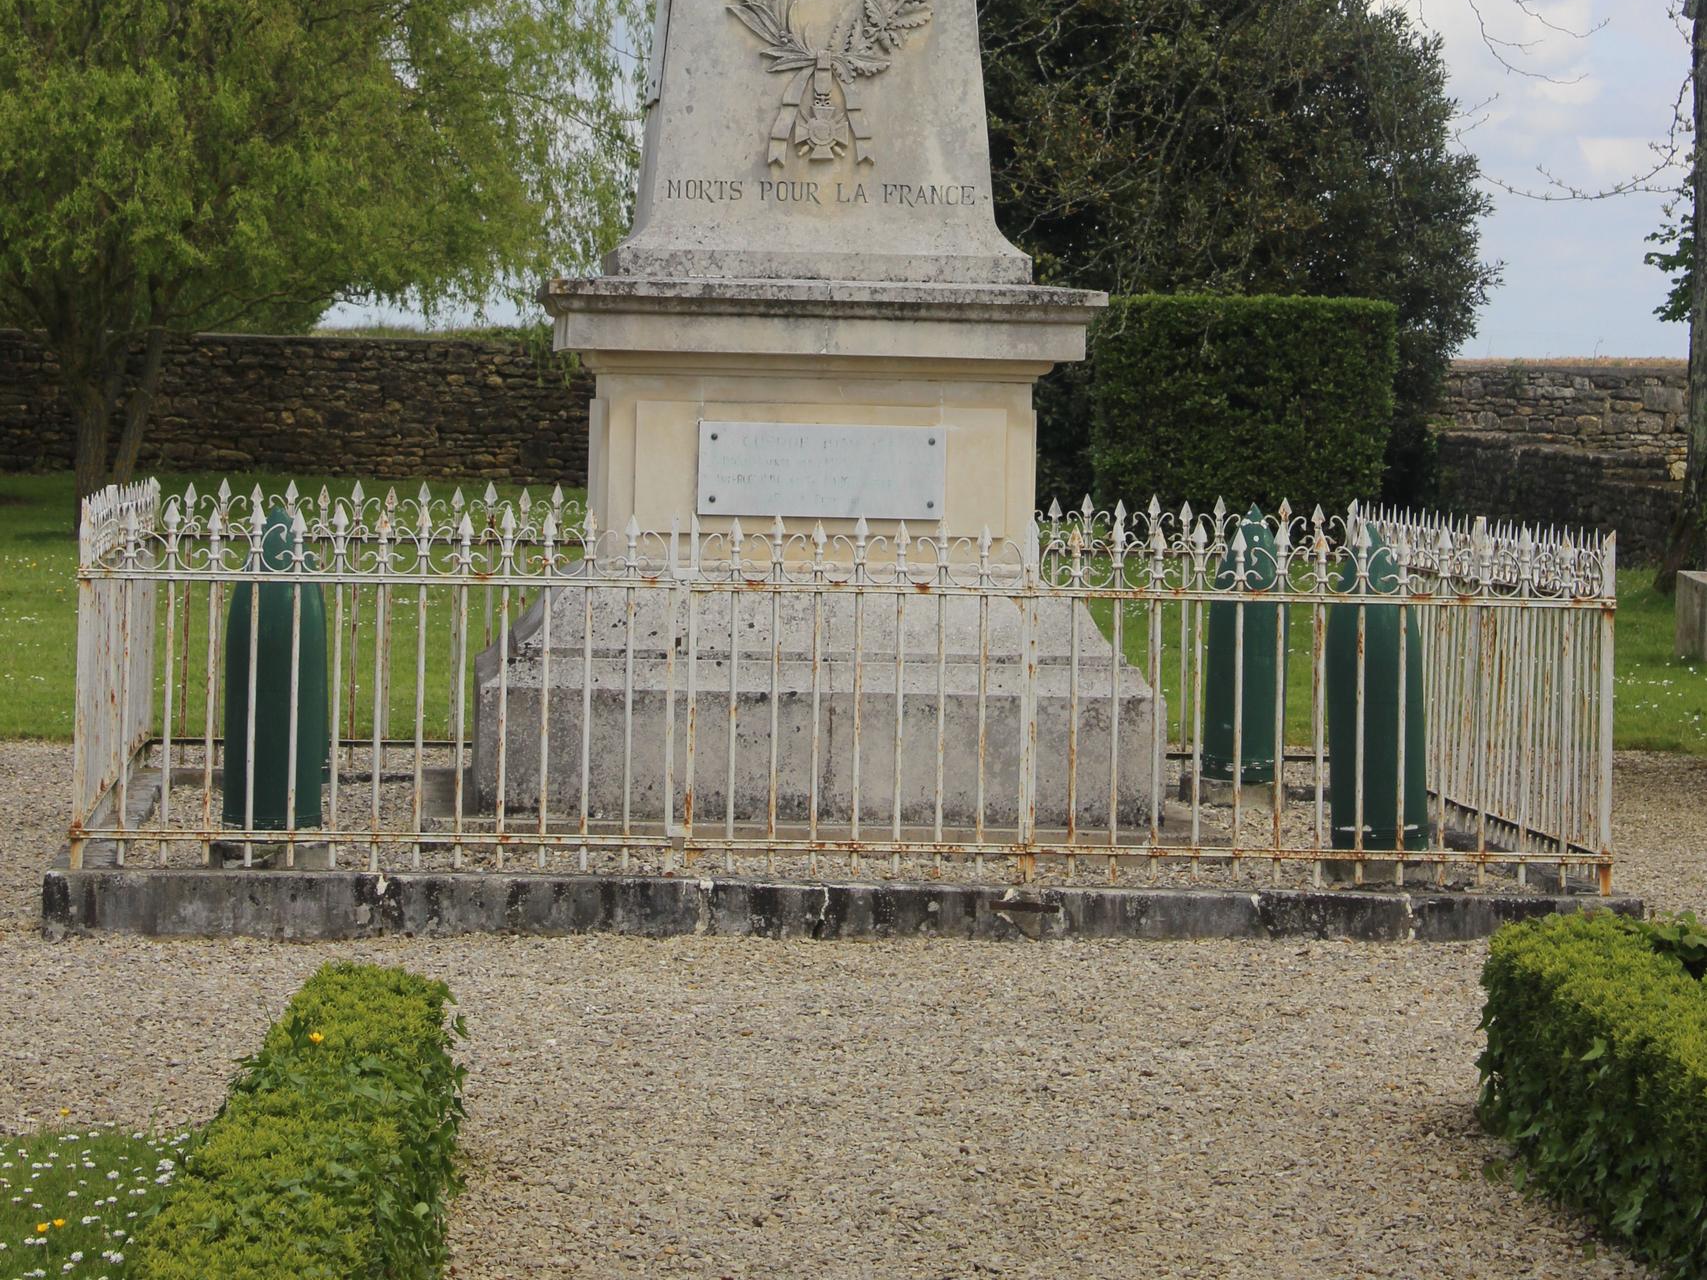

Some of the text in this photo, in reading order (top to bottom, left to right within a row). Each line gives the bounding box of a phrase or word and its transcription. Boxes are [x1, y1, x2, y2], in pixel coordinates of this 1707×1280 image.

[667, 179, 976, 207] MORTS POUR LA FRANCE
